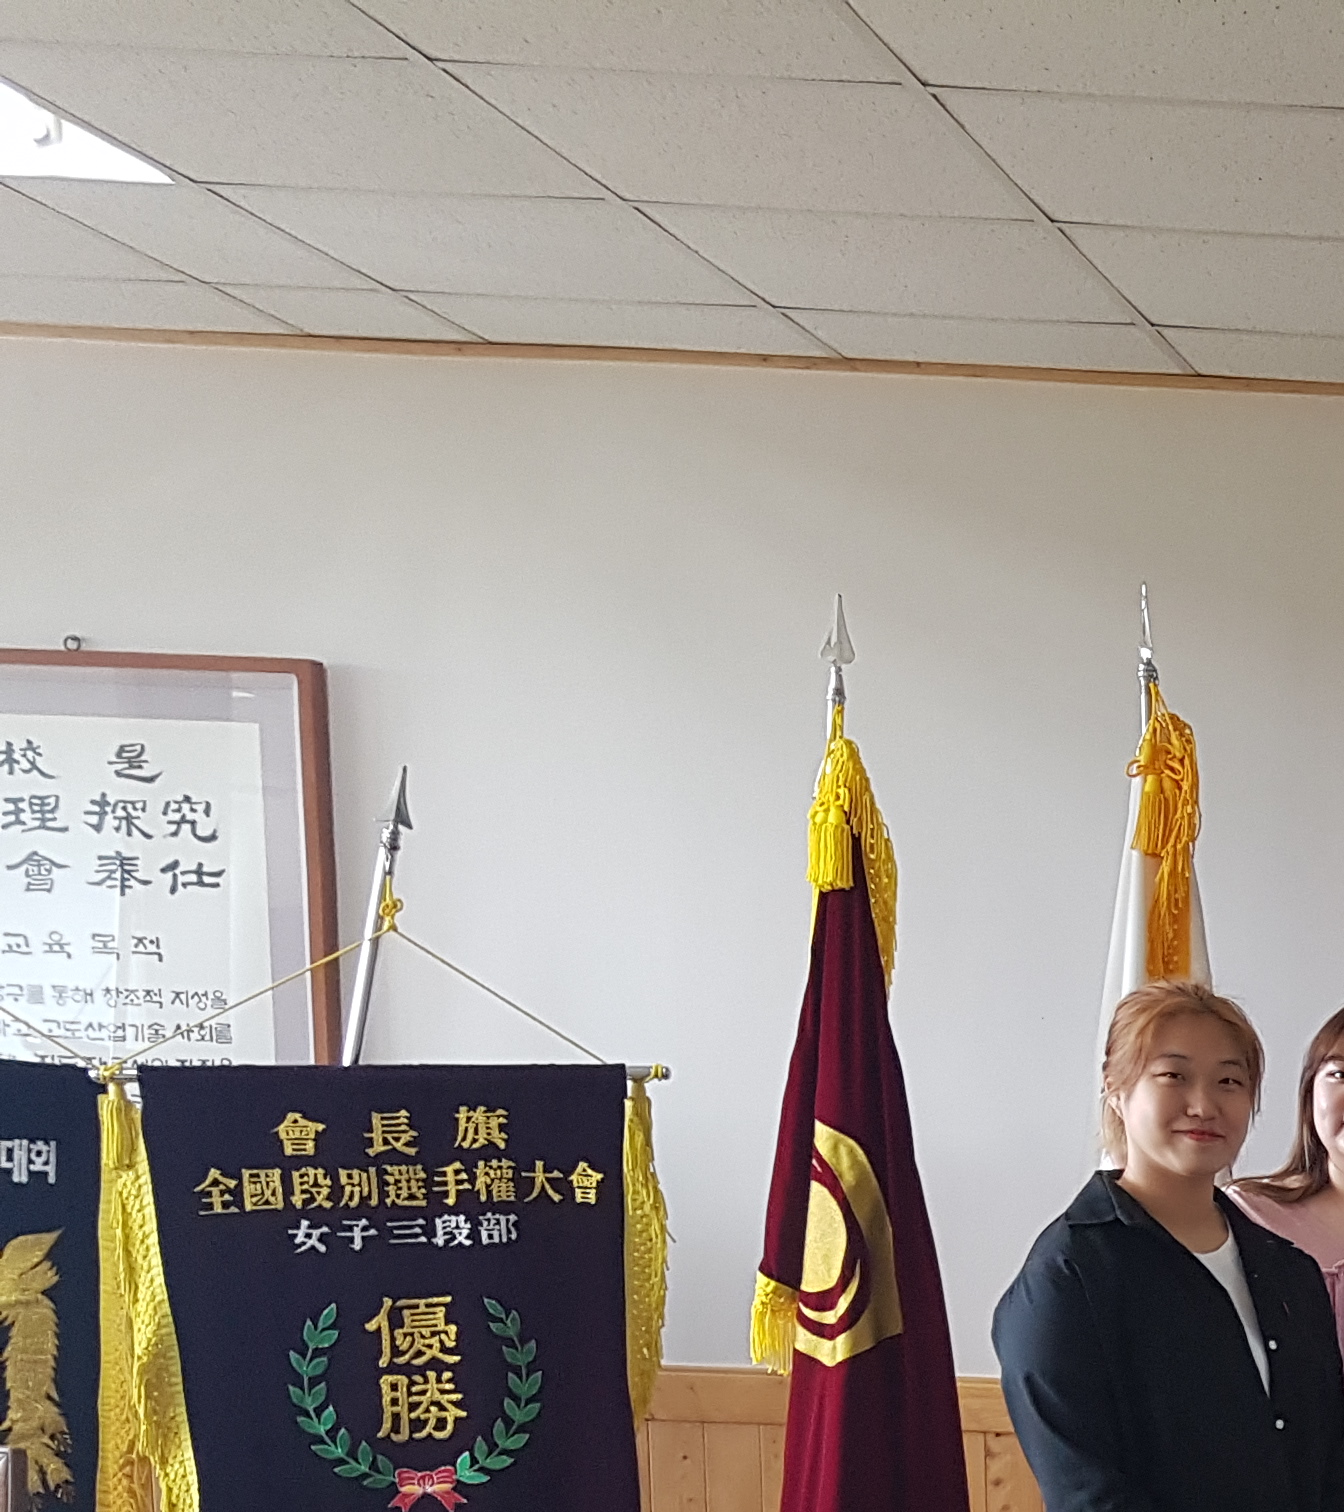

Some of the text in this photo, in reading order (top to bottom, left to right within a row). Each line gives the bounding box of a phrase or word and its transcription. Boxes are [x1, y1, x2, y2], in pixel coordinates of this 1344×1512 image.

[101, 987, 164, 1009] 창조적
[170, 990, 228, 1011] 지성을
[287, 1211, 520, 1254] 女子三段部
